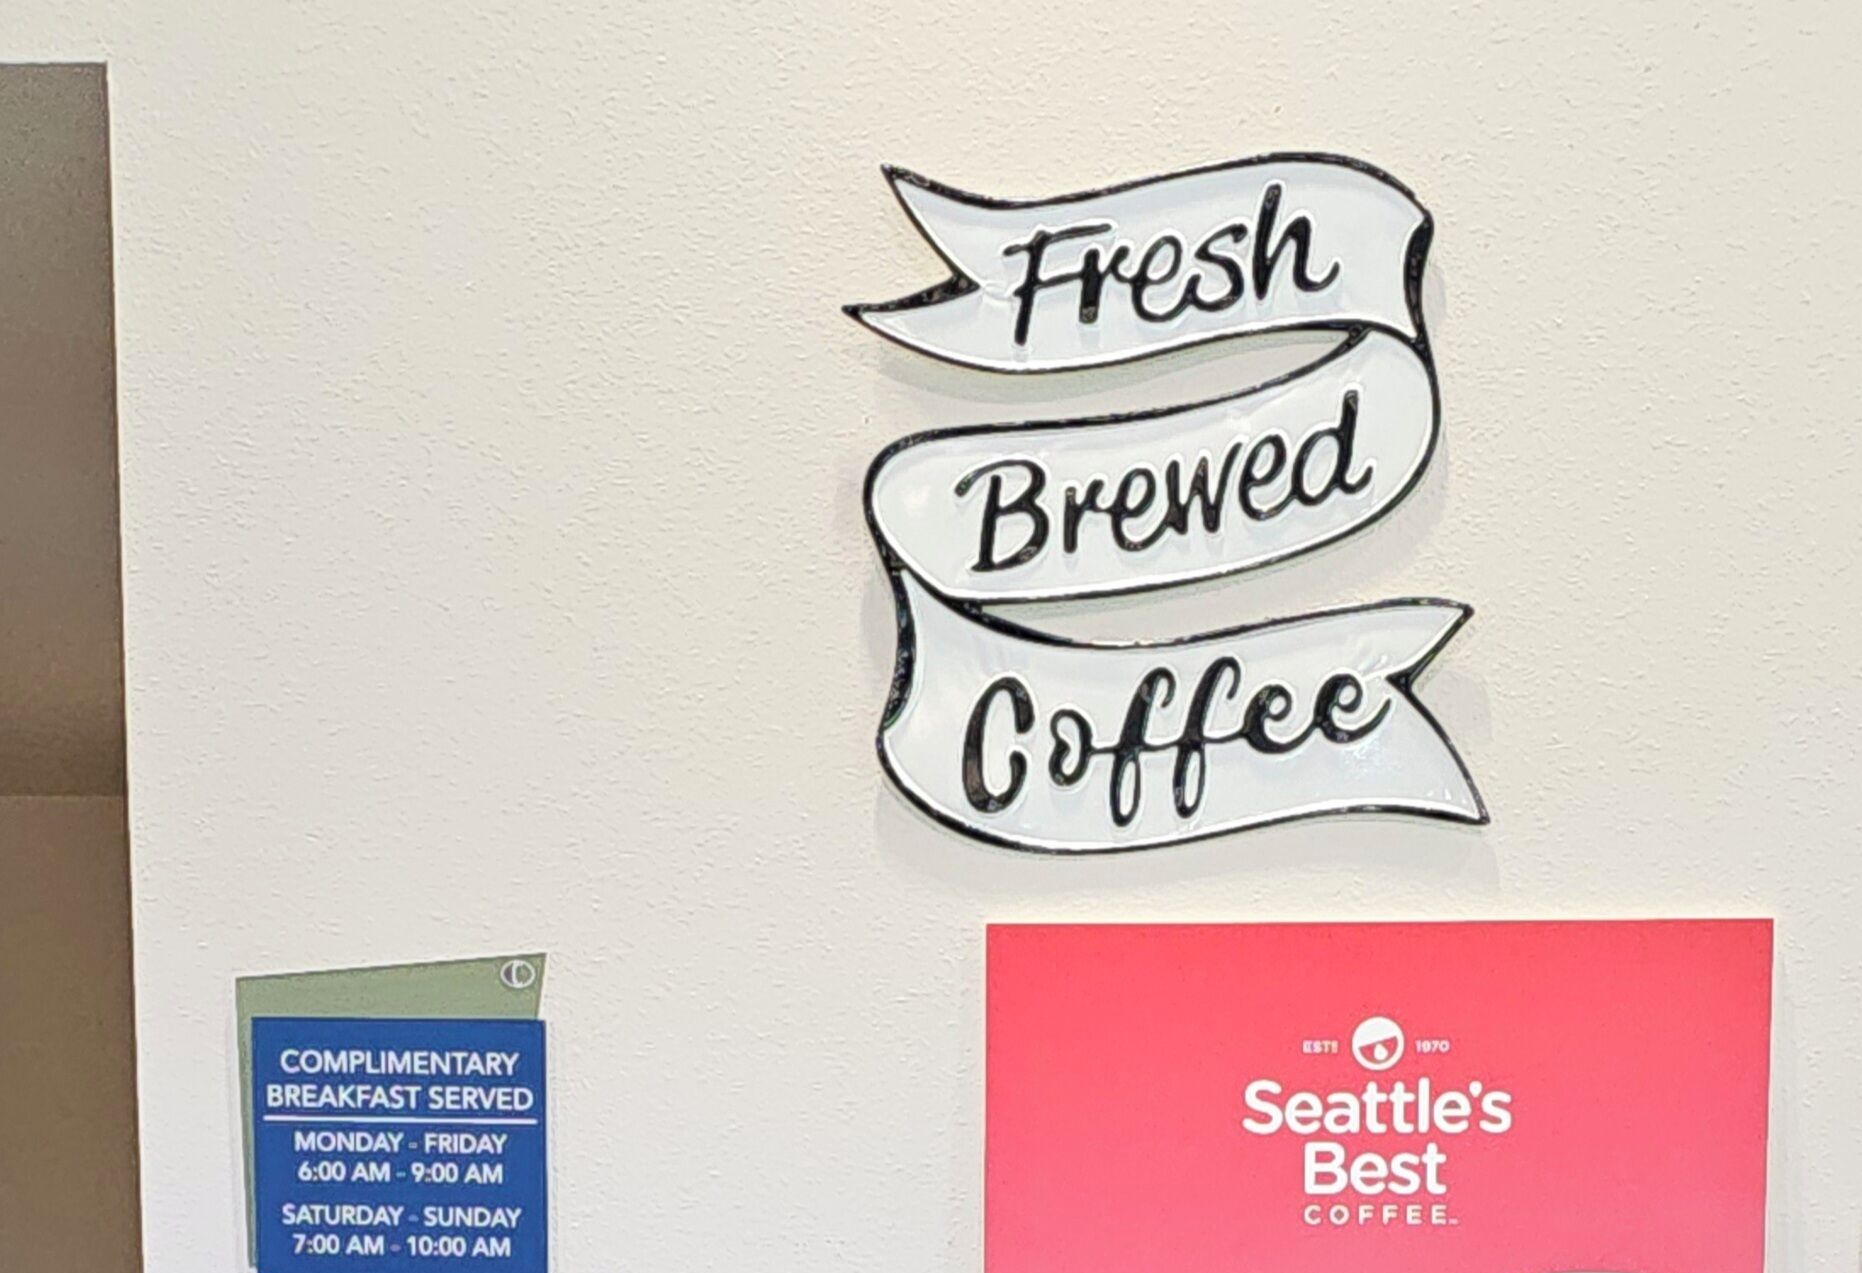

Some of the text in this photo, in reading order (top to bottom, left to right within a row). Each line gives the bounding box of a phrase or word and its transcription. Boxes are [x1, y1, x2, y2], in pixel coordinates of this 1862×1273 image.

[1003, 184, 1340, 346] Fresh
[955, 390, 1373, 572] Brewed
[962, 656, 1391, 826] Coffee
[280, 1049, 519, 1075] COMPLIMENTARY
[266, 1084, 534, 1111] BREAKFAST SERVED
[1242, 1077, 1512, 1134] Seattle's
[294, 1132, 403, 1152] MONDAY
[424, 1133, 508, 1154] FRIDAY
[298, 1161, 346, 1182] 6:00
[352, 1162, 391, 1182] AM
[411, 1163, 459, 1183] 9:00
[464, 1164, 503, 1184] AM
[1304, 1142, 1447, 1194] Best
[281, 1204, 404, 1226] SATURDAY
[423, 1206, 522, 1228] SUNDAY
[292, 1234, 340, 1255] 7:00
[345, 1235, 384, 1255] AM
[407, 1236, 468, 1257] 10:00
[472, 1236, 511, 1257] AM
